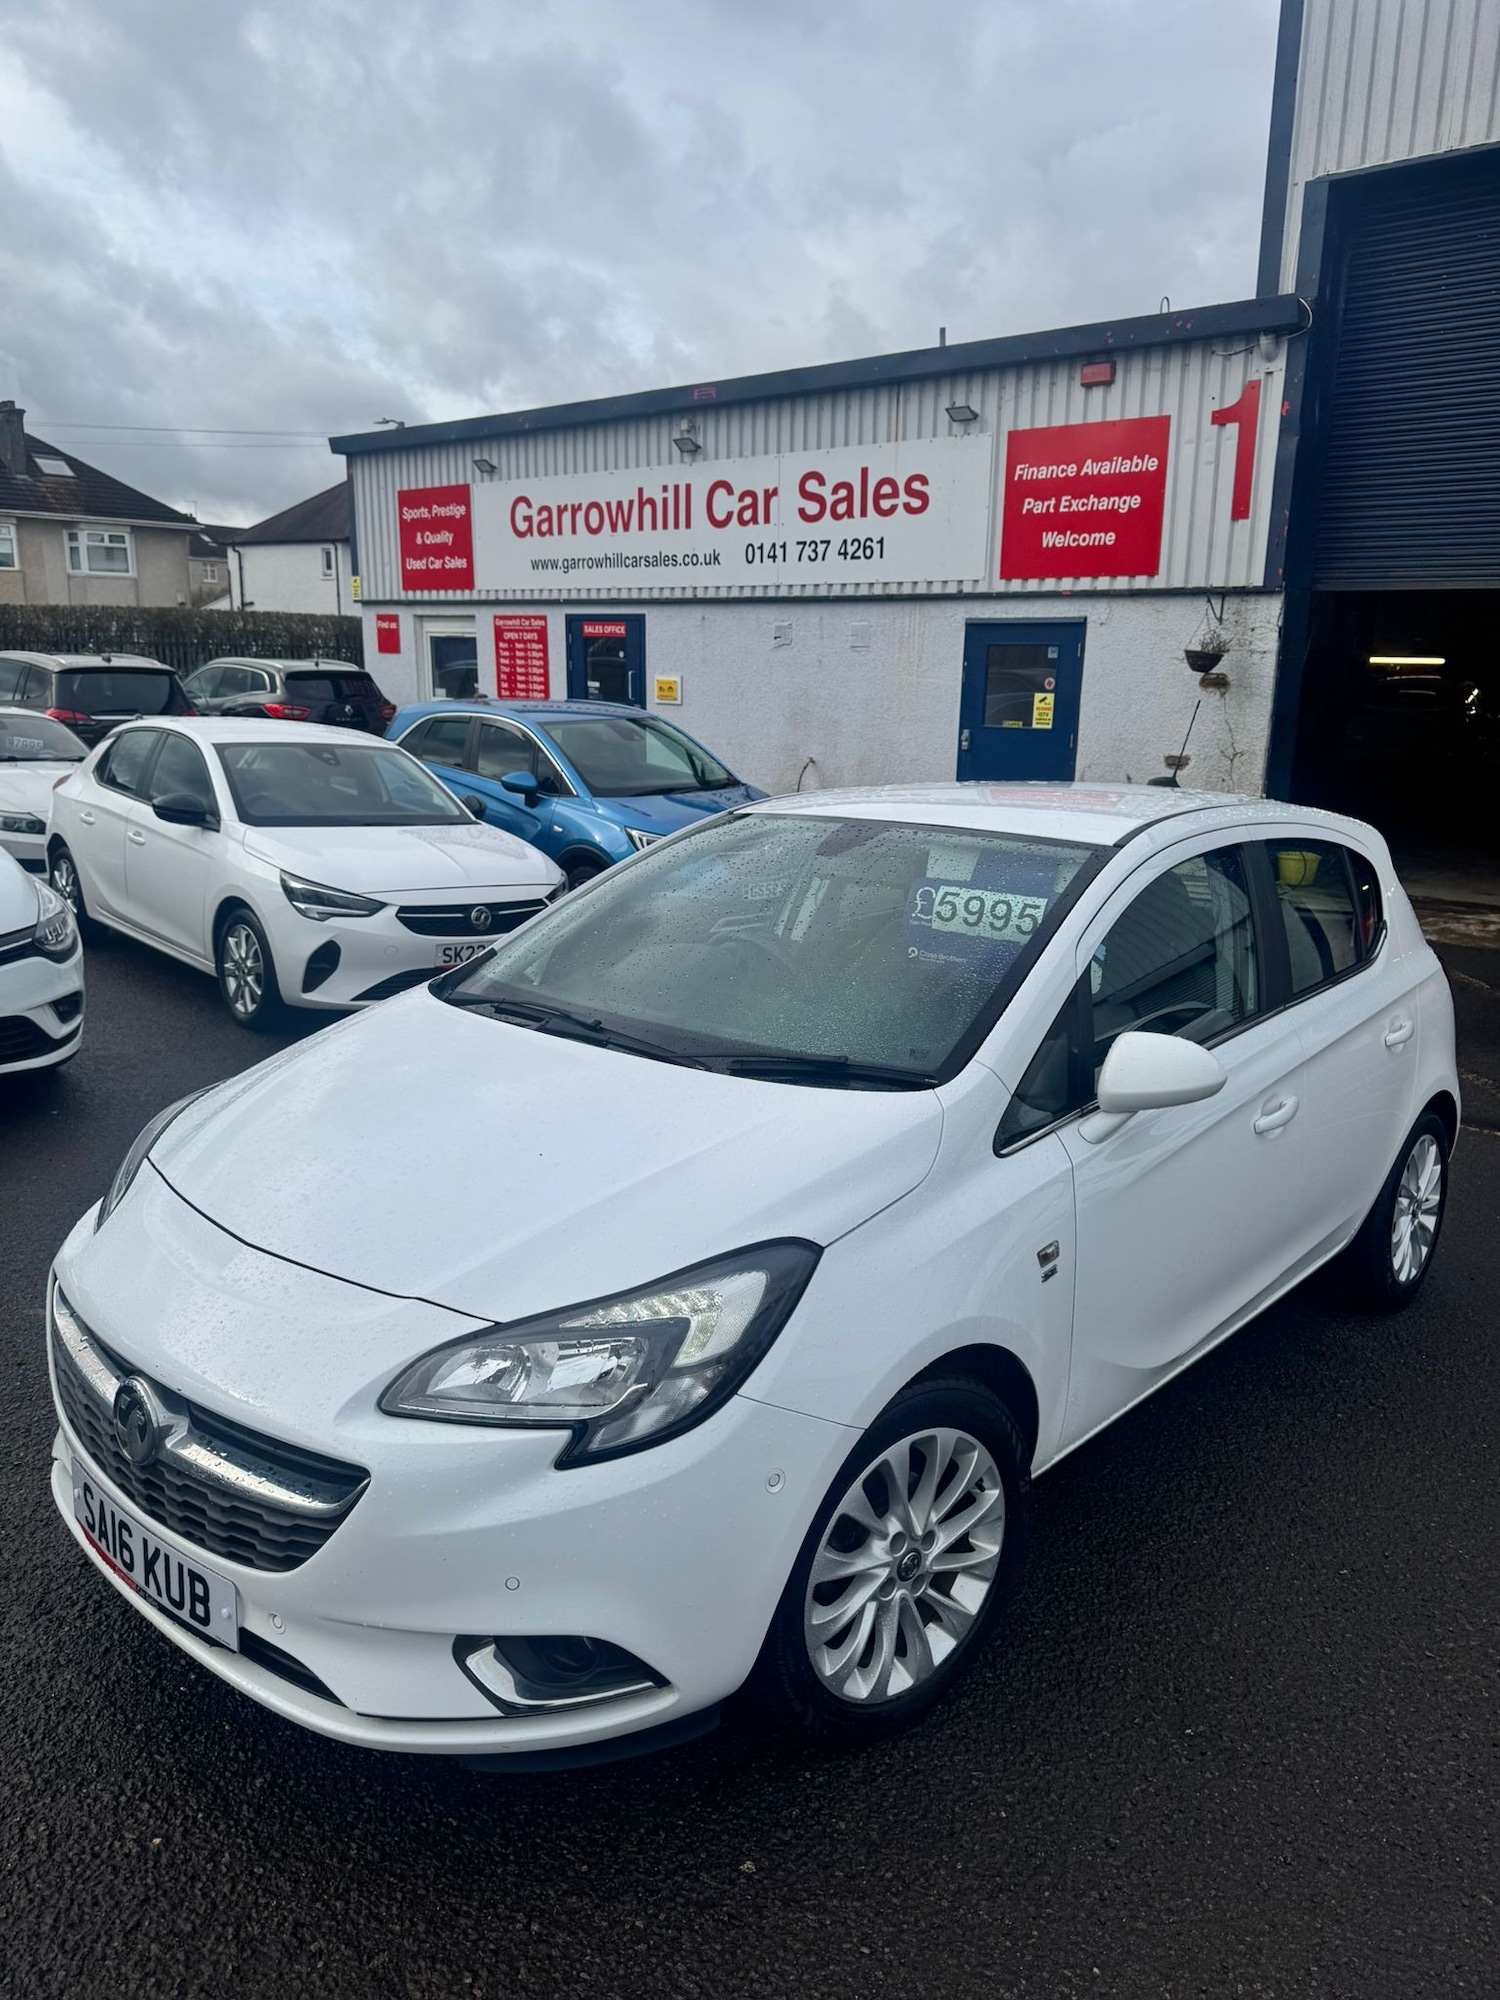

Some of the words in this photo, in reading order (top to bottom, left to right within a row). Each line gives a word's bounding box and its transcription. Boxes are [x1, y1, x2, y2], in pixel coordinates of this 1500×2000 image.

[1014, 463, 1077, 481] Finance
[1080, 454, 1158, 477] Available
[402, 506, 431, 522] Sports,
[432, 503, 466, 519] Prestige
[509, 483, 692, 539] Garrowhill
[705, 479, 778, 529] Car
[797, 466, 930, 523] Sales
[1022, 498, 1055, 514] Part
[1059, 493, 1141, 515] Exchange
[416, 532, 422, 545] &
[424, 530, 454, 546] Quality
[1041, 530, 1116, 548] Welcome
[530, 548, 721, 574] www.garrowhillcarsales.co.uk
[745, 541, 787, 564] 0141
[796, 539, 831, 563] 737
[837, 536, 884, 561] 4261
[406, 557, 427, 570] Used
[428, 556, 443, 569] Car
[444, 556, 468, 569] Sales
[583, 625, 603, 634] SALES
[604, 625, 626, 634] OFFICE
[911, 886, 1042, 936] £5995
[442, 945, 486, 964] SK2
[83, 1482, 134, 1573] SA16
[143, 1537, 211, 1627] KUB
